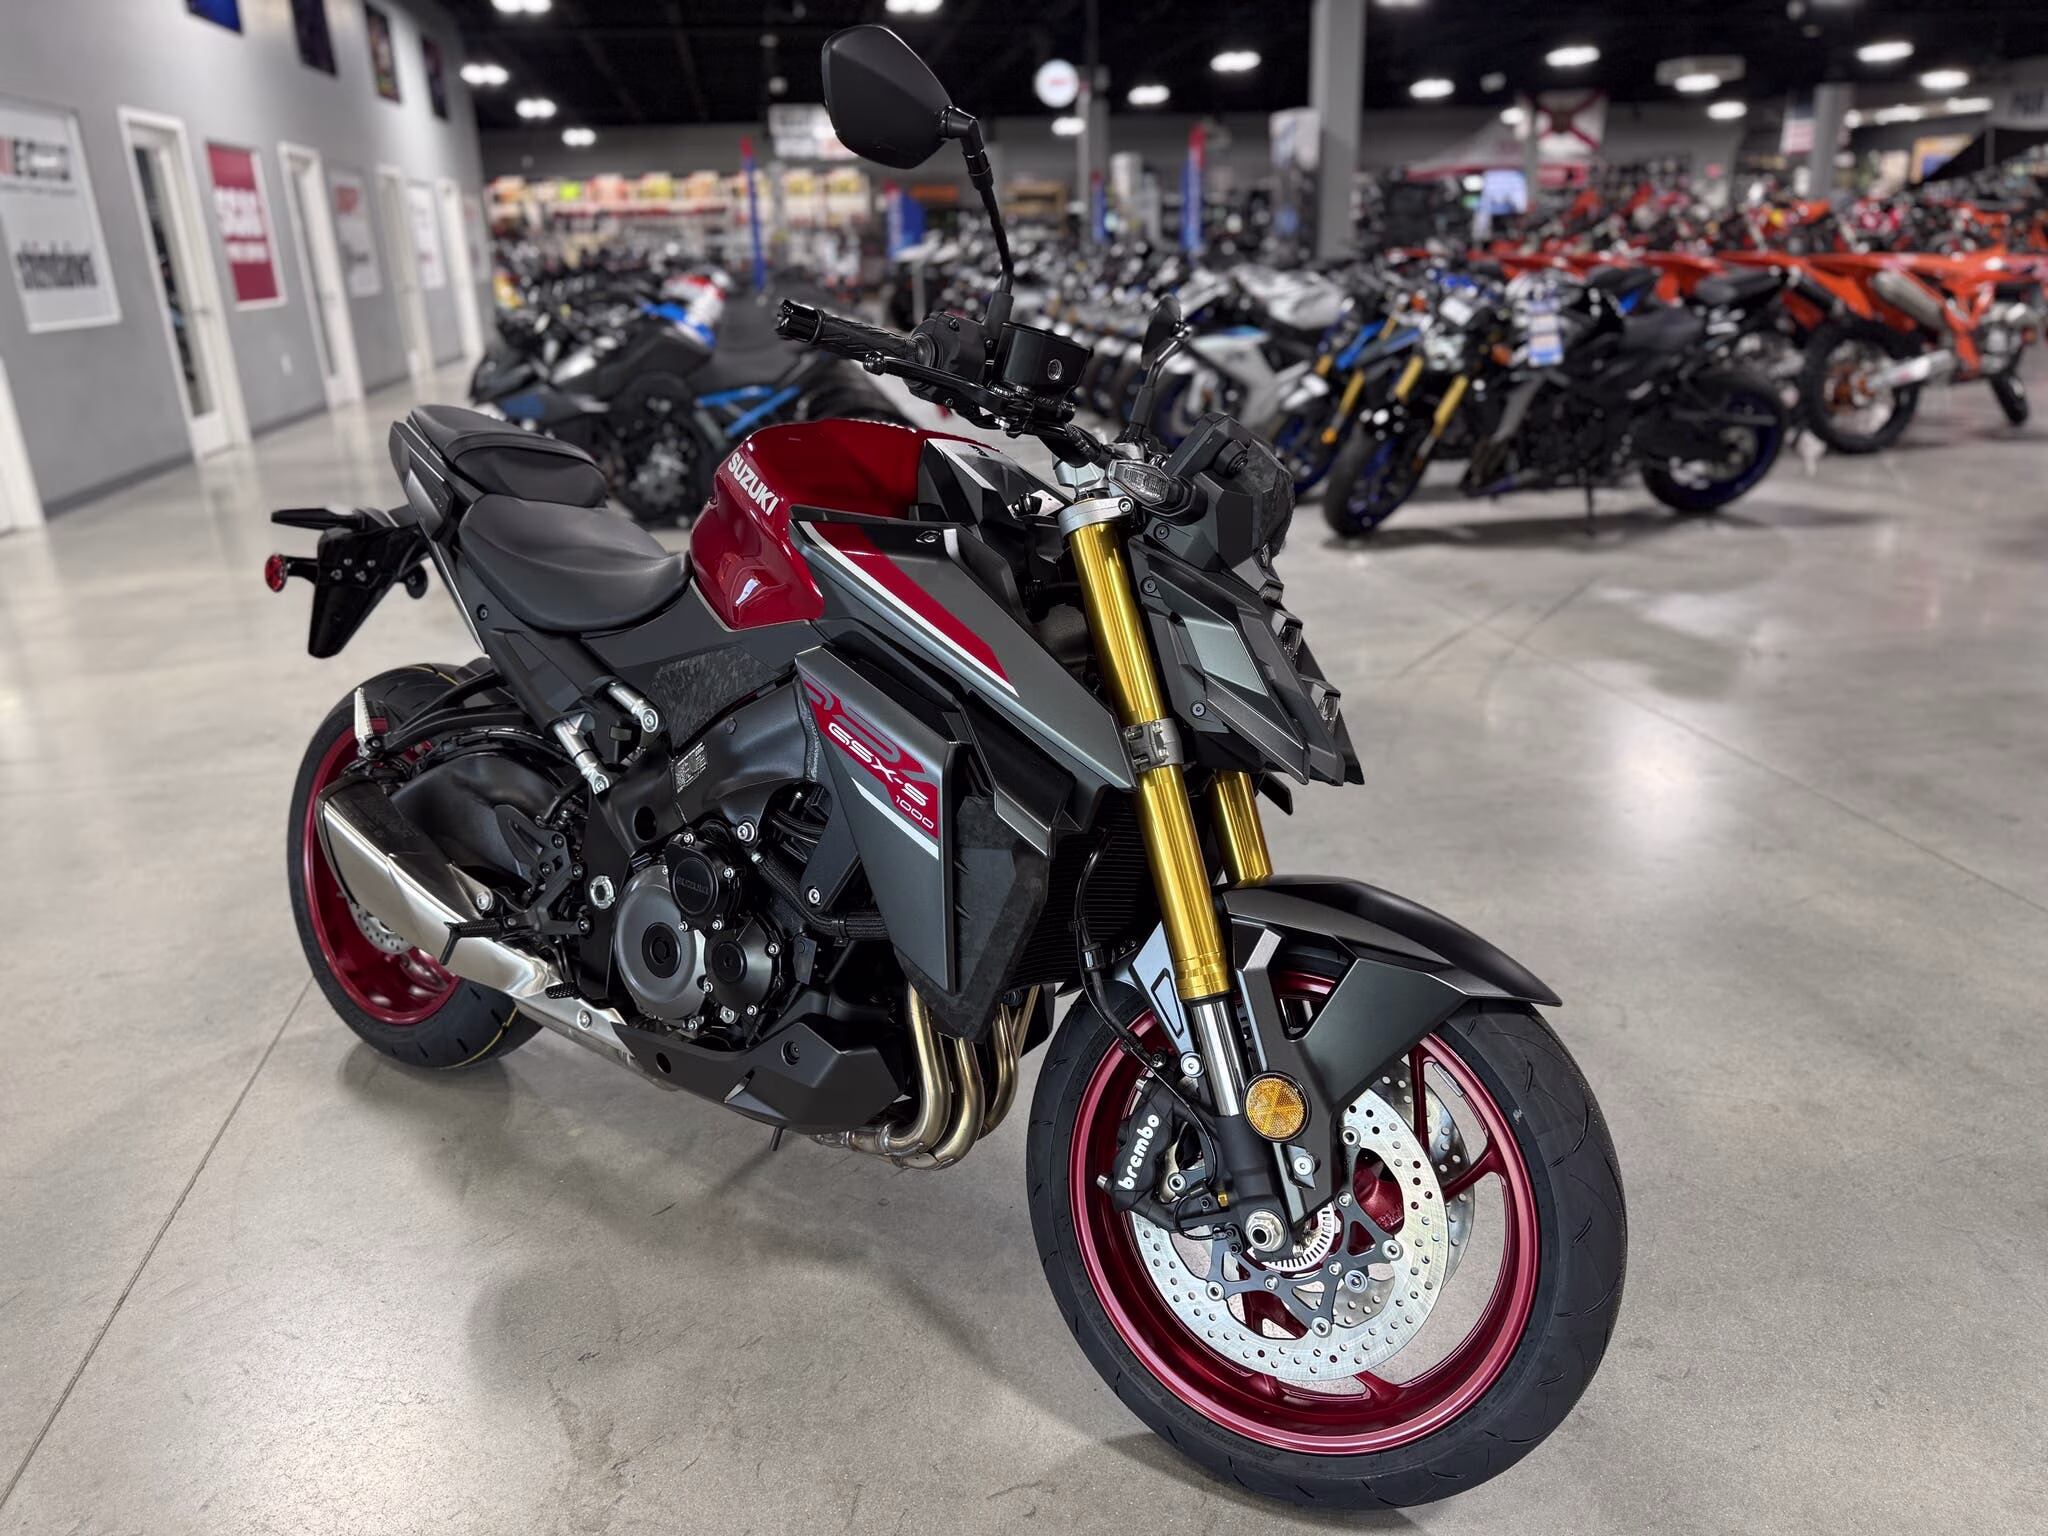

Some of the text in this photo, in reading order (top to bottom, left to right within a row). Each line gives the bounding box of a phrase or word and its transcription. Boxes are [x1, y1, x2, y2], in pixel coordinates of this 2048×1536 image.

[728, 452, 780, 516] SUZUKI
[828, 722, 929, 806] GSX-S
[896, 795, 934, 829] 1000
[1118, 1114, 1160, 1190] brembo
